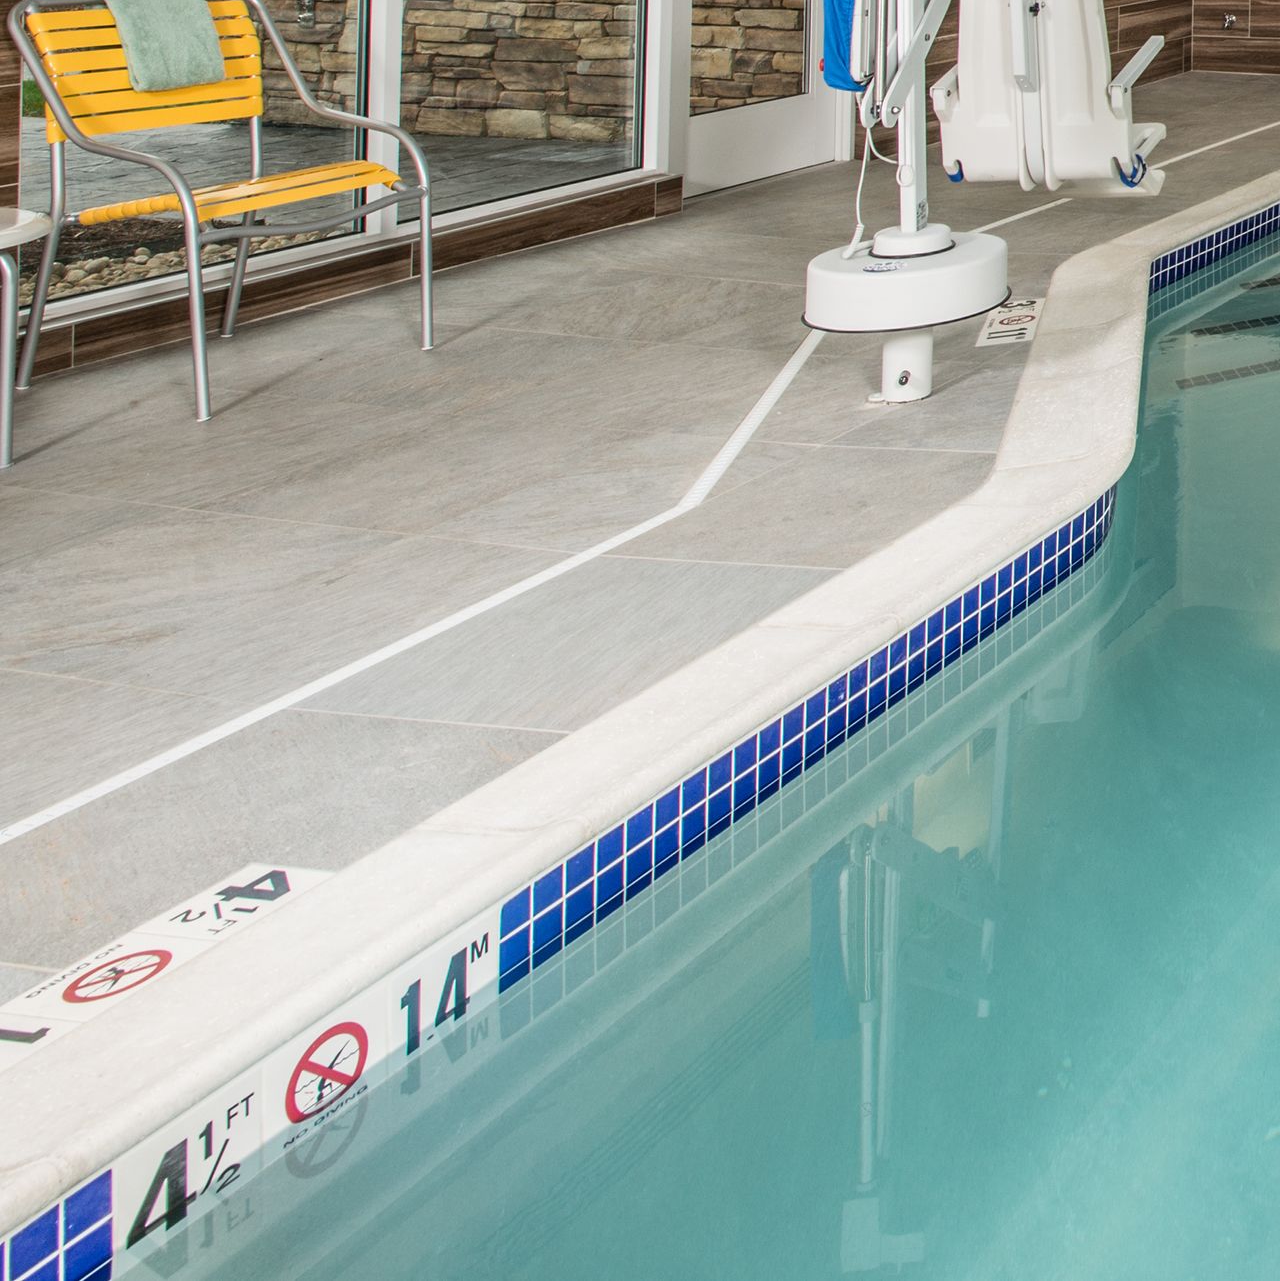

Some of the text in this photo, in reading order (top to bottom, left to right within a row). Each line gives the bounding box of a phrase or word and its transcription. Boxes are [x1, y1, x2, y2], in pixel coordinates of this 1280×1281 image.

[214, 869, 291, 901] 4
[227, 1092, 255, 1130] FT
[283, 1085, 368, 1149] NO DIVING
